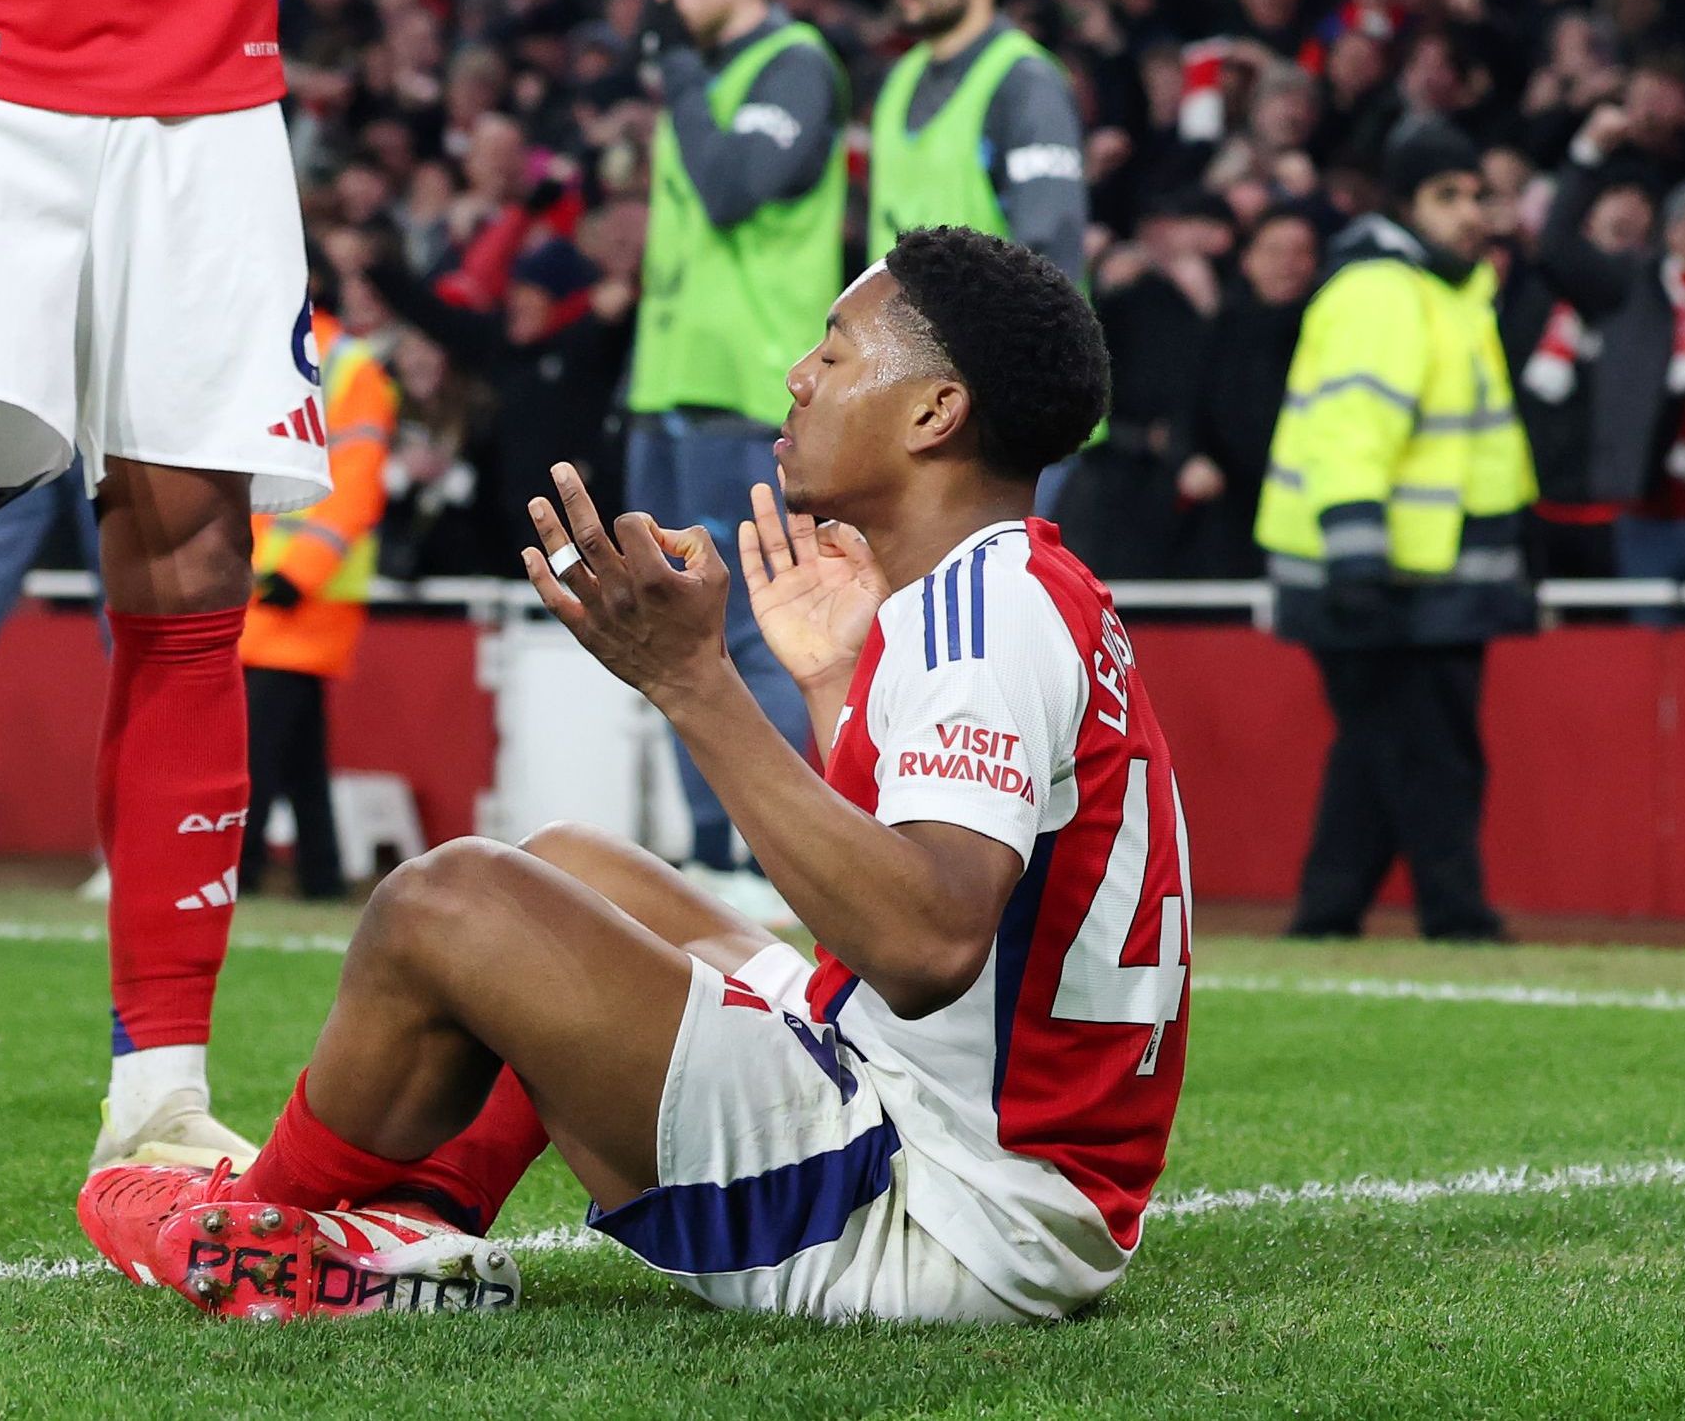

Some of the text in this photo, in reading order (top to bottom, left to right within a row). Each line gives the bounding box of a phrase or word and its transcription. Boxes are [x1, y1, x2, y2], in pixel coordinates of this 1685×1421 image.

[935, 723, 1020, 761] VISIT
[899, 751, 1035, 806] RWANDA
[1049, 757, 1194, 1076] 4
